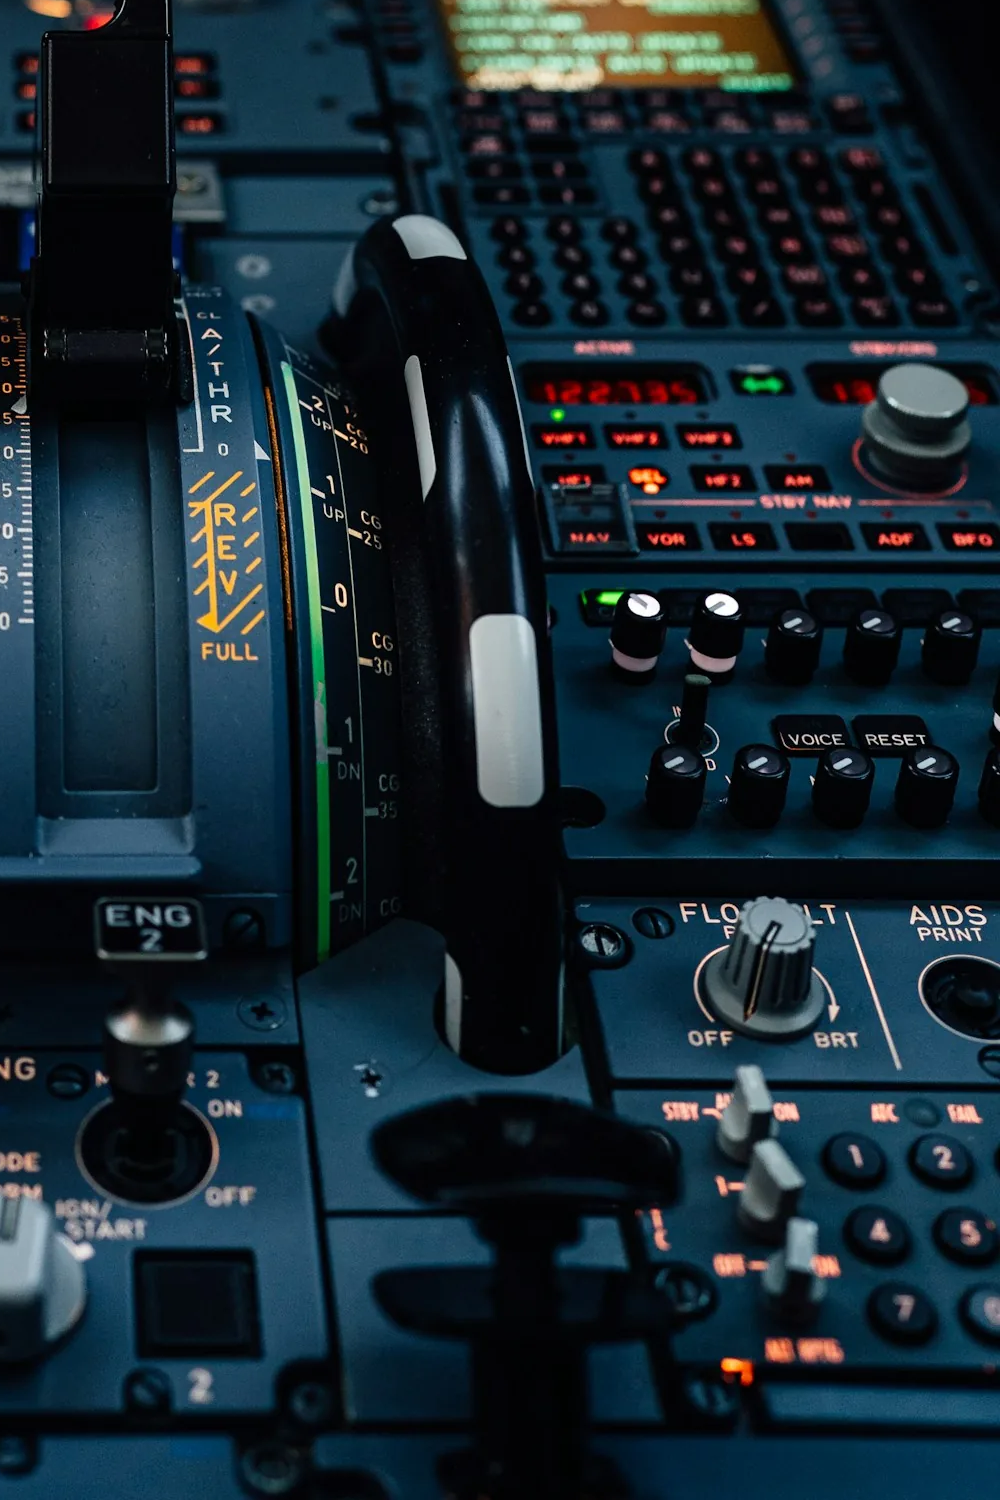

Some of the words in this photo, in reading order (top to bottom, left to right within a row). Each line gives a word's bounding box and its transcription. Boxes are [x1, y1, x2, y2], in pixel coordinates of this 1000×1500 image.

[197, 312, 221, 320] CL
[311, 395, 326, 413] 2
[311, 414, 332, 432] UP
[326, 474, 336, 495] 1
[784, 474, 814, 488] AM
[812, 494, 853, 509] NAV
[323, 503, 344, 523] UP
[360, 510, 383, 530] CG
[362, 530, 383, 551] 25
[569, 532, 610, 544] NAV
[647, 533, 687, 547] VOR
[731, 533, 757, 547] LS
[878, 532, 914, 546] ADF
[952, 532, 994, 547] BFO
[214, 503, 237, 595] REV
[334, 582, 348, 608] 0
[372, 631, 394, 651] CG
[201, 642, 259, 662] FULL
[373, 656, 393, 677] 30
[344, 716, 353, 744] 1
[787, 733, 846, 747] VOICE
[864, 734, 926, 747] RESET
[337, 760, 362, 781] DN
[345, 857, 359, 884] 2
[105, 904, 192, 929] ENG
[909, 904, 988, 927] AIDS
[140, 929, 163, 953] 2
[916, 926, 983, 943] PRINT
[687, 1030, 734, 1048] OFF
[813, 1031, 859, 1049] BRT
[206, 1069, 220, 1089] 2
[207, 1098, 244, 1118] ON
[848, 1144, 865, 1169] 1
[931, 1144, 957, 1171] 2
[204, 1185, 258, 1208] OFF
[64, 1218, 148, 1241] START
[868, 1217, 892, 1244] 4
[959, 1219, 983, 1247] 5
[892, 1293, 917, 1322] 7
[187, 1366, 215, 1405] 2
